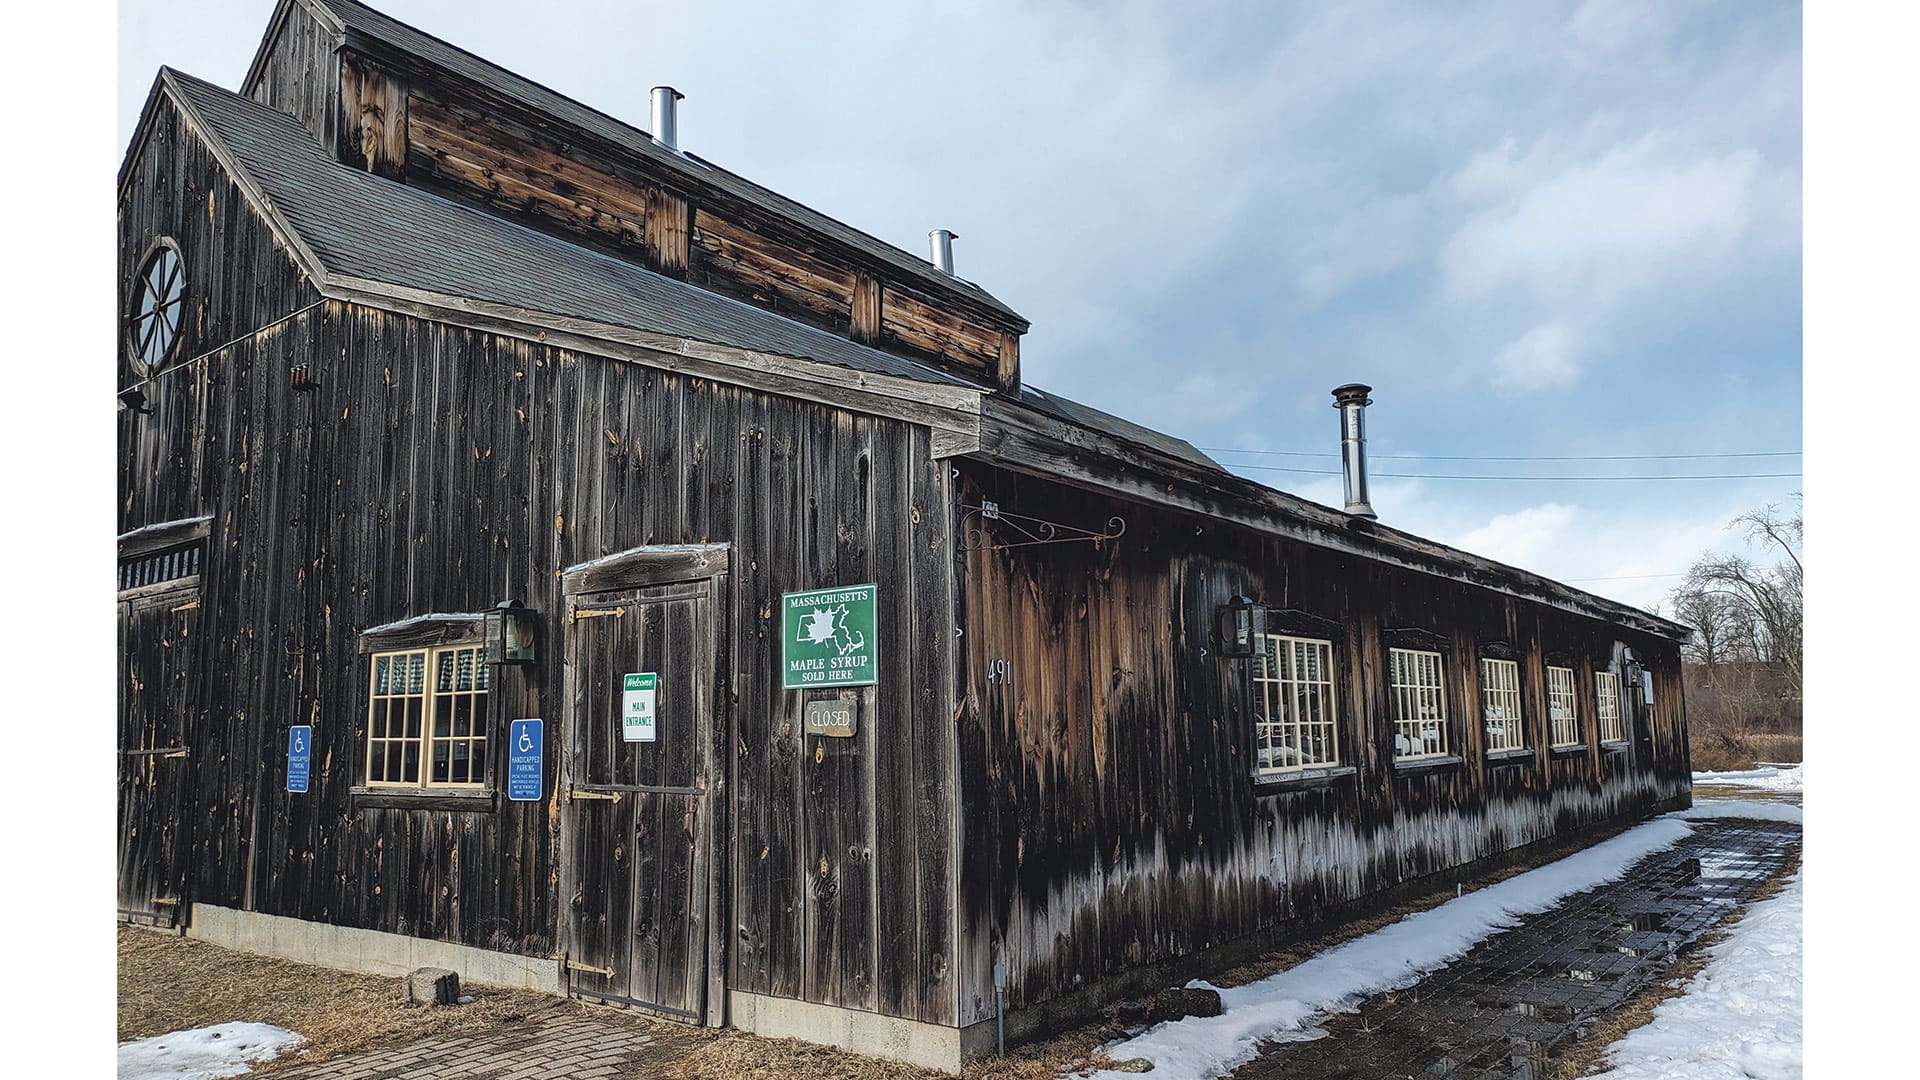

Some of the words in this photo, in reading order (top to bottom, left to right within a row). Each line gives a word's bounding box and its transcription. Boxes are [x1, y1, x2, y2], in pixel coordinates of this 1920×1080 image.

[790, 591, 868, 608] MASSACHUSETTS
[790, 658, 825, 671] MAPLE
[830, 655, 868, 668] SYRUP
[802, 671, 825, 682] SOLD
[828, 670, 853, 680] HERE
[988, 659, 1011, 685] 491
[627, 677, 653, 687] Welcome
[632, 702, 645, 712] MAIN
[626, 716, 652, 726] ENTRANCE
[811, 710, 849, 727] CLOSED
